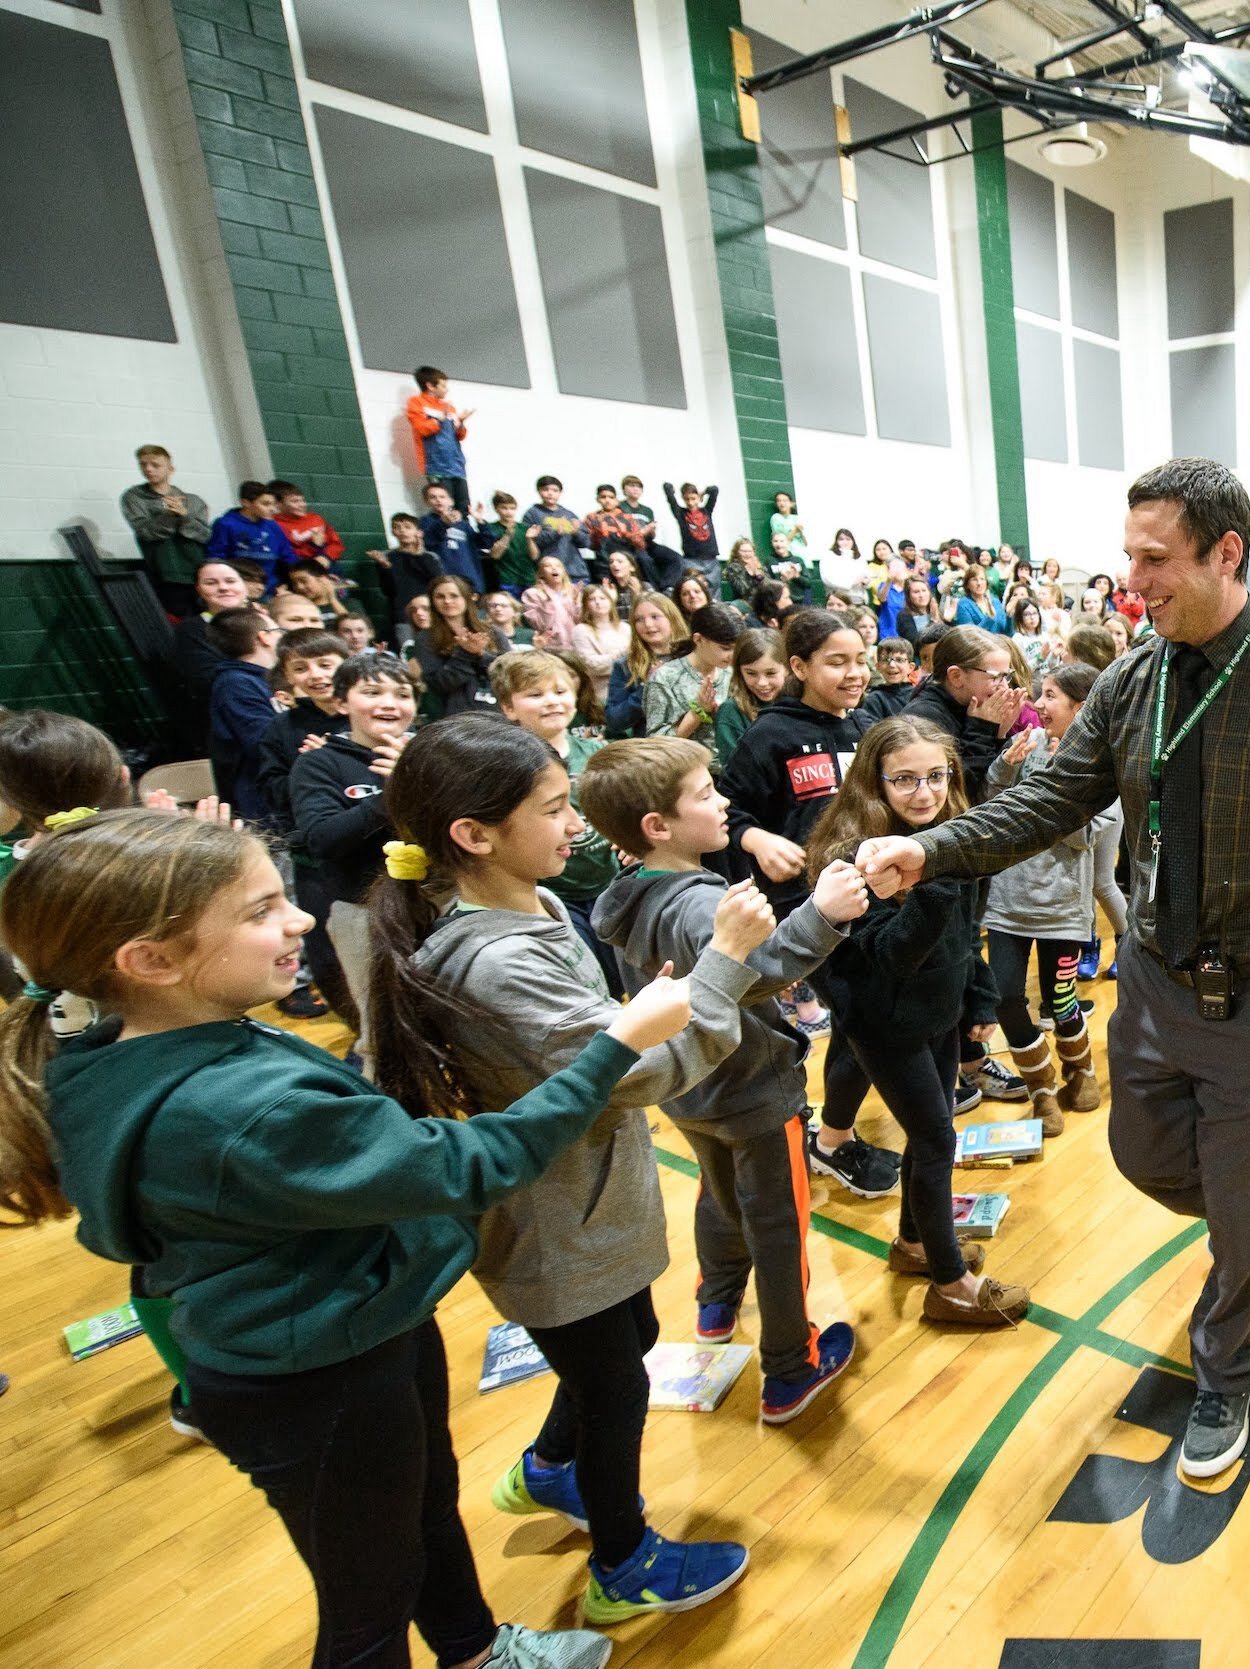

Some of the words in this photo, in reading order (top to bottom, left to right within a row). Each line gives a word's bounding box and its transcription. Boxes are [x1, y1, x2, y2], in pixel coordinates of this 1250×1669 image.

[1229, 640, 1249, 667] Highland
[1160, 673, 1168, 701] Highland
[1156, 701, 1165, 737] Elementary
[1165, 728, 1185, 753] Highland
[1183, 697, 1209, 729] Elementary
[1205, 679, 1223, 701] School
